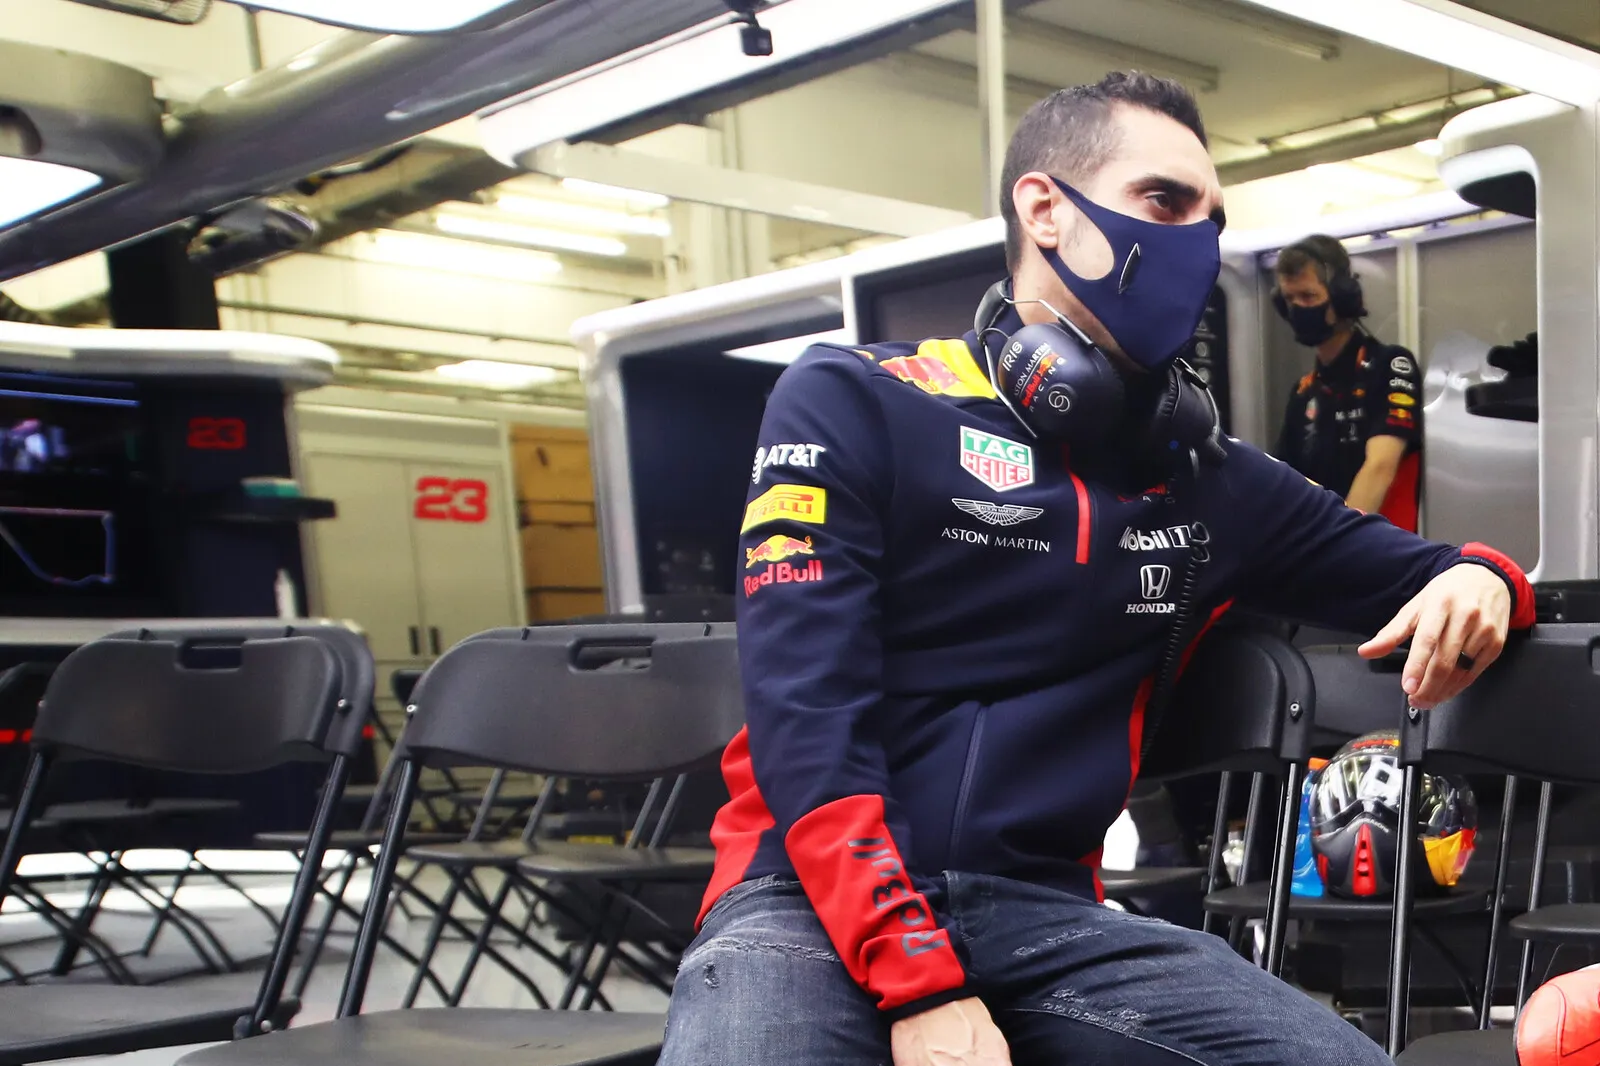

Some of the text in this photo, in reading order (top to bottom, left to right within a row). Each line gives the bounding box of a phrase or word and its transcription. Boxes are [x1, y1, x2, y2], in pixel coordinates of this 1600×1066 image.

[1002, 341, 1023, 372] IRIS
[187, 417, 246, 450] 23
[966, 431, 1027, 465] TAG
[762, 443, 827, 468] AT&T
[964, 453, 1030, 486] HEUER
[414, 476, 488, 523] 23
[941, 527, 1050, 553] ASTON MARTIN
[1118, 526, 1171, 551] Mobil
[744, 564, 774, 598] Red
[776, 560, 823, 583] Bull
[1125, 603, 1176, 614] HONDA
